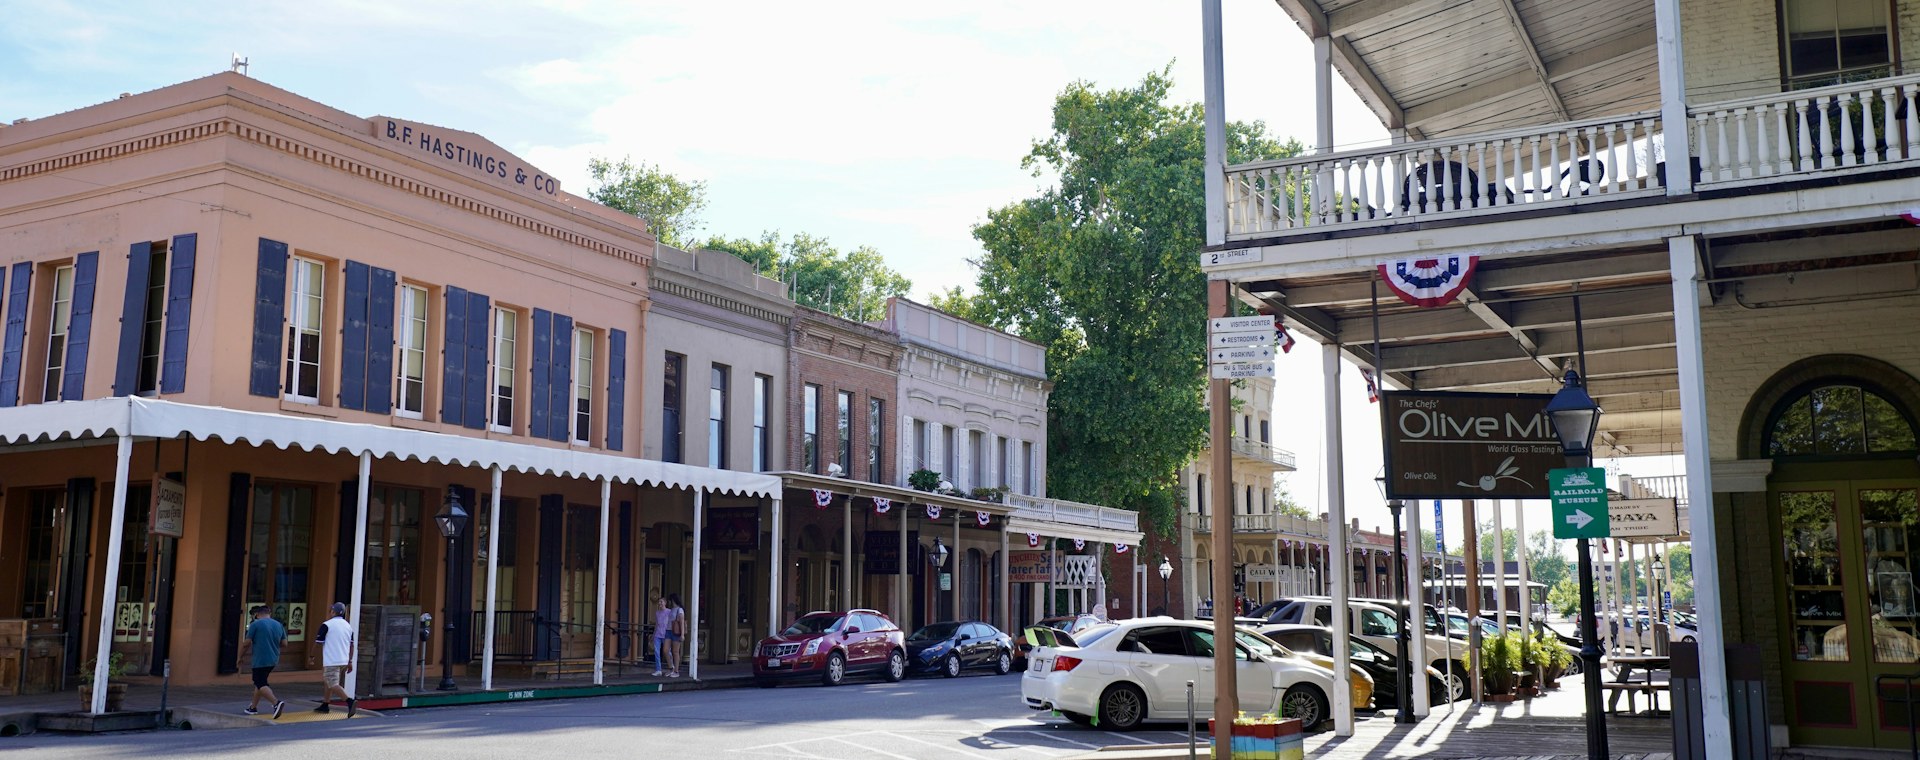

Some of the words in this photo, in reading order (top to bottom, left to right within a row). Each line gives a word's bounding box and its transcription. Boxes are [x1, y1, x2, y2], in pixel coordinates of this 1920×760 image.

[420, 132, 507, 179] HASTINGS
[515, 167, 528, 185] &
[534, 174, 557, 197] CO.
[1227, 249, 1249, 258] STREET
[1230, 320, 1250, 328] VISITOR
[1251, 319, 1271, 327] CENTER
[1227, 335, 1259, 343] RESTROOMS
[1230, 350, 1256, 358] PARKING
[1399, 399, 1413, 408] The
[1399, 408, 1499, 438] Olive
[1505, 412, 1558, 438] Mi
[1487, 444, 1509, 453] World
[1510, 444, 1529, 453] Class
[1530, 444, 1555, 455] Tasting
[1403, 471, 1422, 480] Olive
[1423, 471, 1437, 480] Oils
[1553, 488, 1604, 496] RAILROAD
[1558, 496, 1598, 504] MUSEUM
[1608, 512, 1658, 522] MAYA
[1008, 564, 1033, 574] ater
[1034, 563, 1062, 579] Tafy
[508, 691, 514, 699] 15
[514, 691, 523, 699] MIN
[523, 690, 535, 698] ZONE
